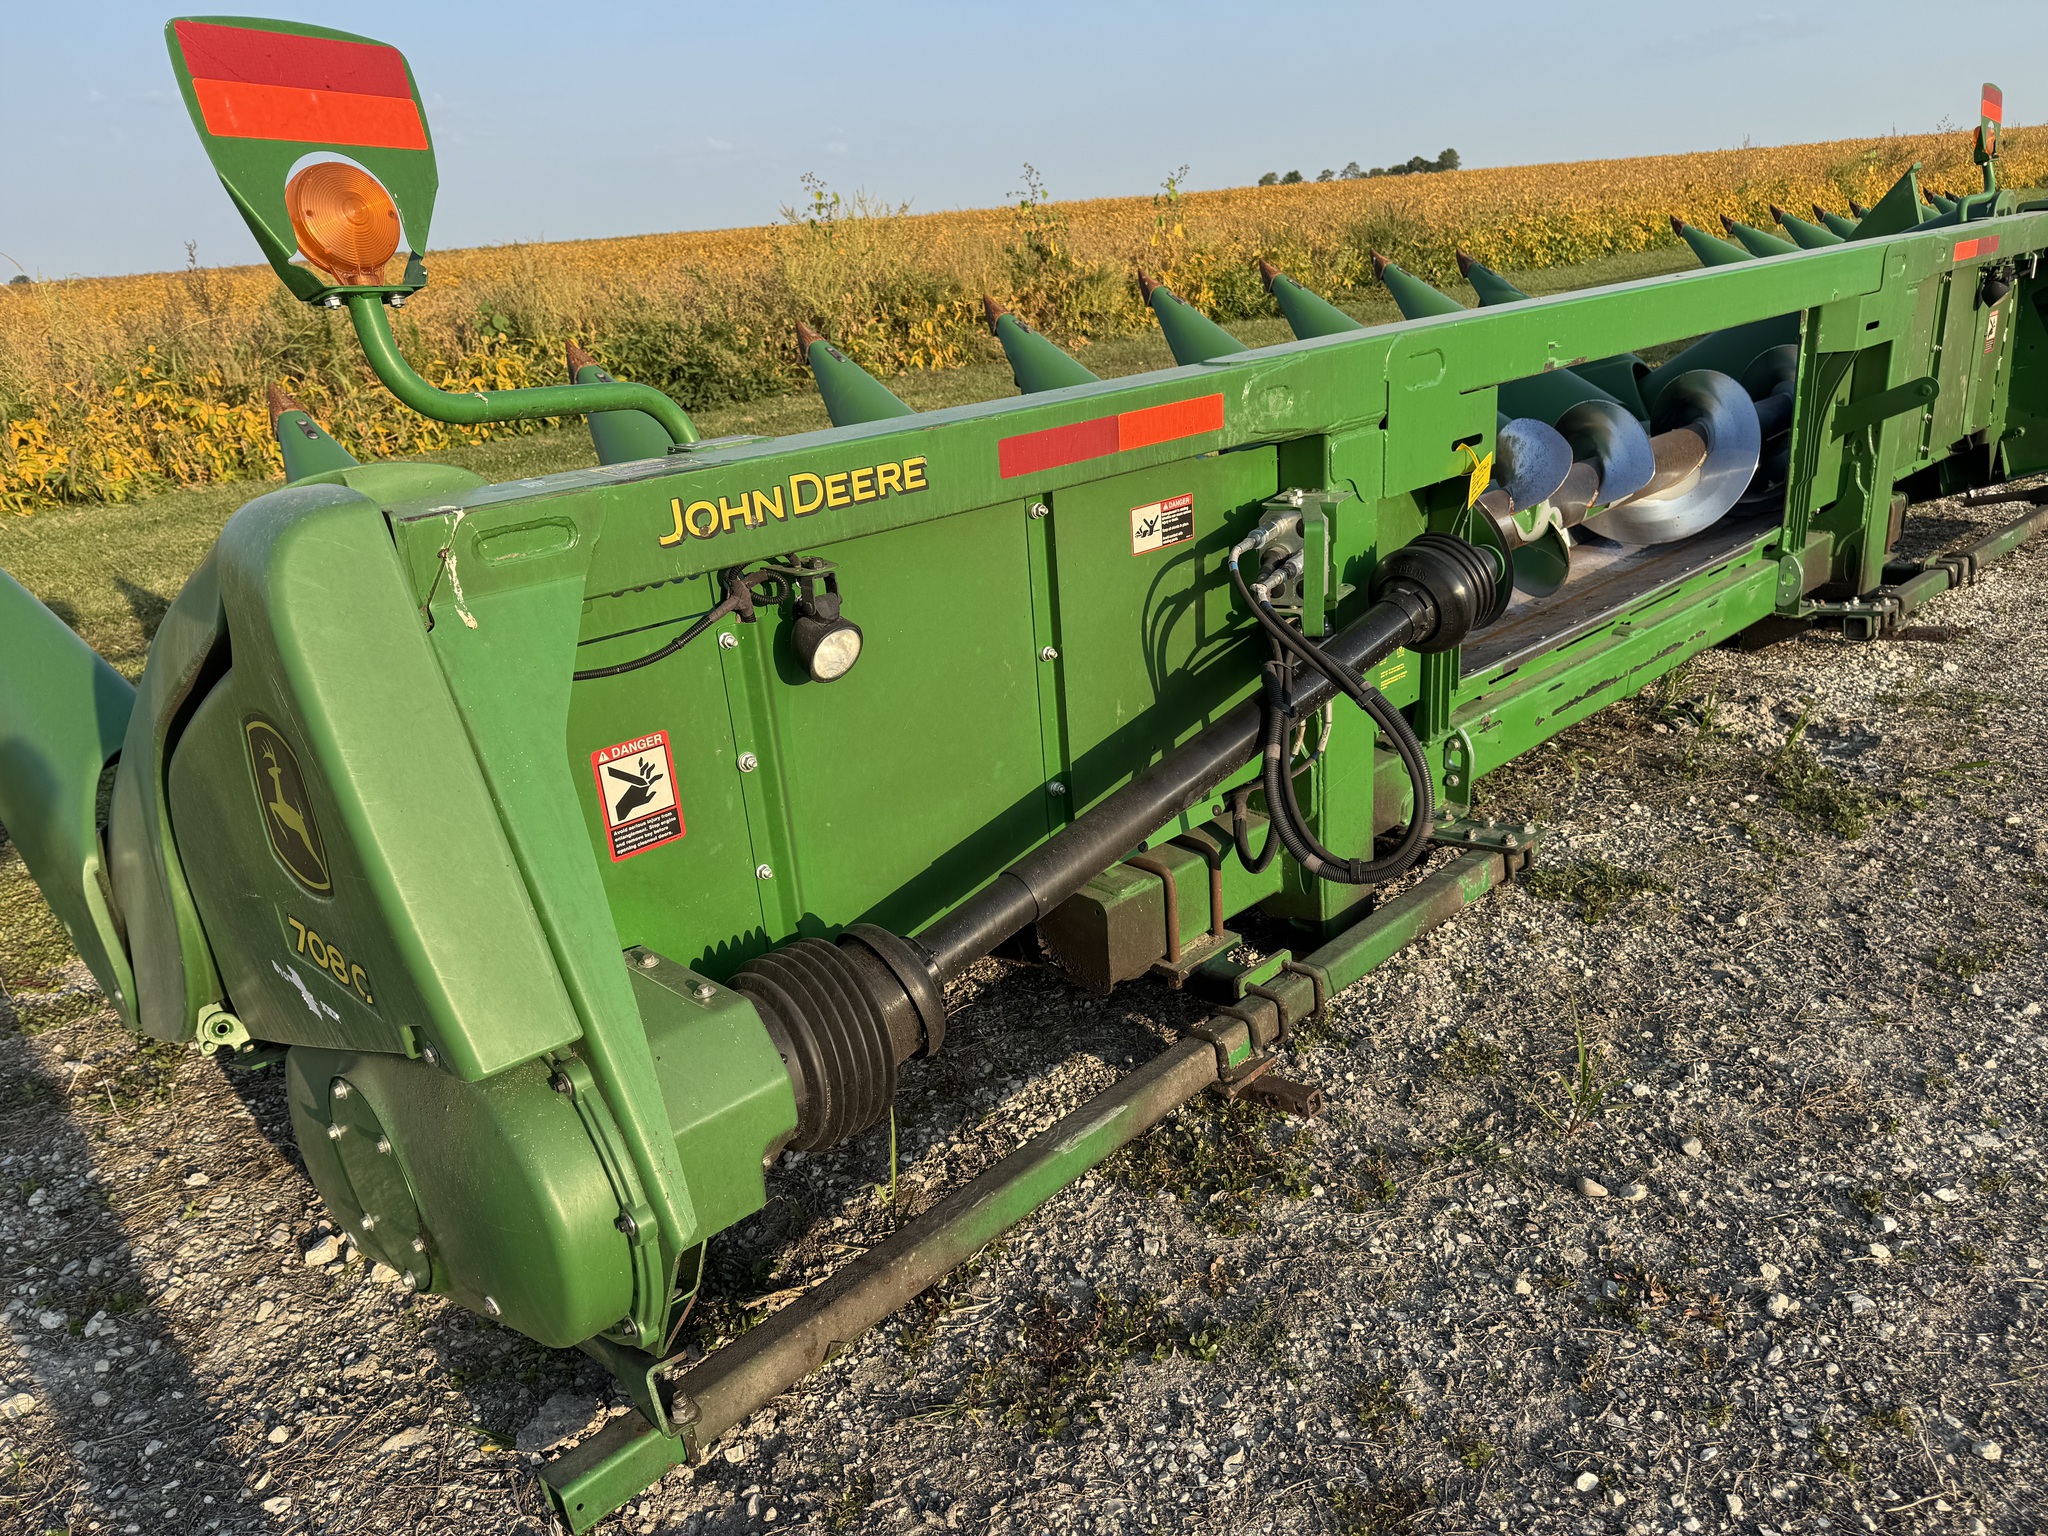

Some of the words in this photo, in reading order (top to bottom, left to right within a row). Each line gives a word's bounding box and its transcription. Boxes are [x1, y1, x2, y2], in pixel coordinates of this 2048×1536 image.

[659, 486, 786, 548] JOHN
[788, 456, 929, 516] DEERE
[1168, 497, 1190, 509] DANGER
[611, 734, 662, 758] DANGER
[614, 827, 628, 836] Avoid
[629, 821, 646, 831] serious
[647, 816, 661, 825] injury
[661, 811, 673, 819] from
[661, 816, 676, 825] engine
[617, 844, 637, 854] opening
[637, 836, 657, 847] cleanout
[626, 835, 644, 844] remove
[644, 831, 653, 839] key
[654, 826, 669, 834] before
[287, 914, 374, 1004] 708C
